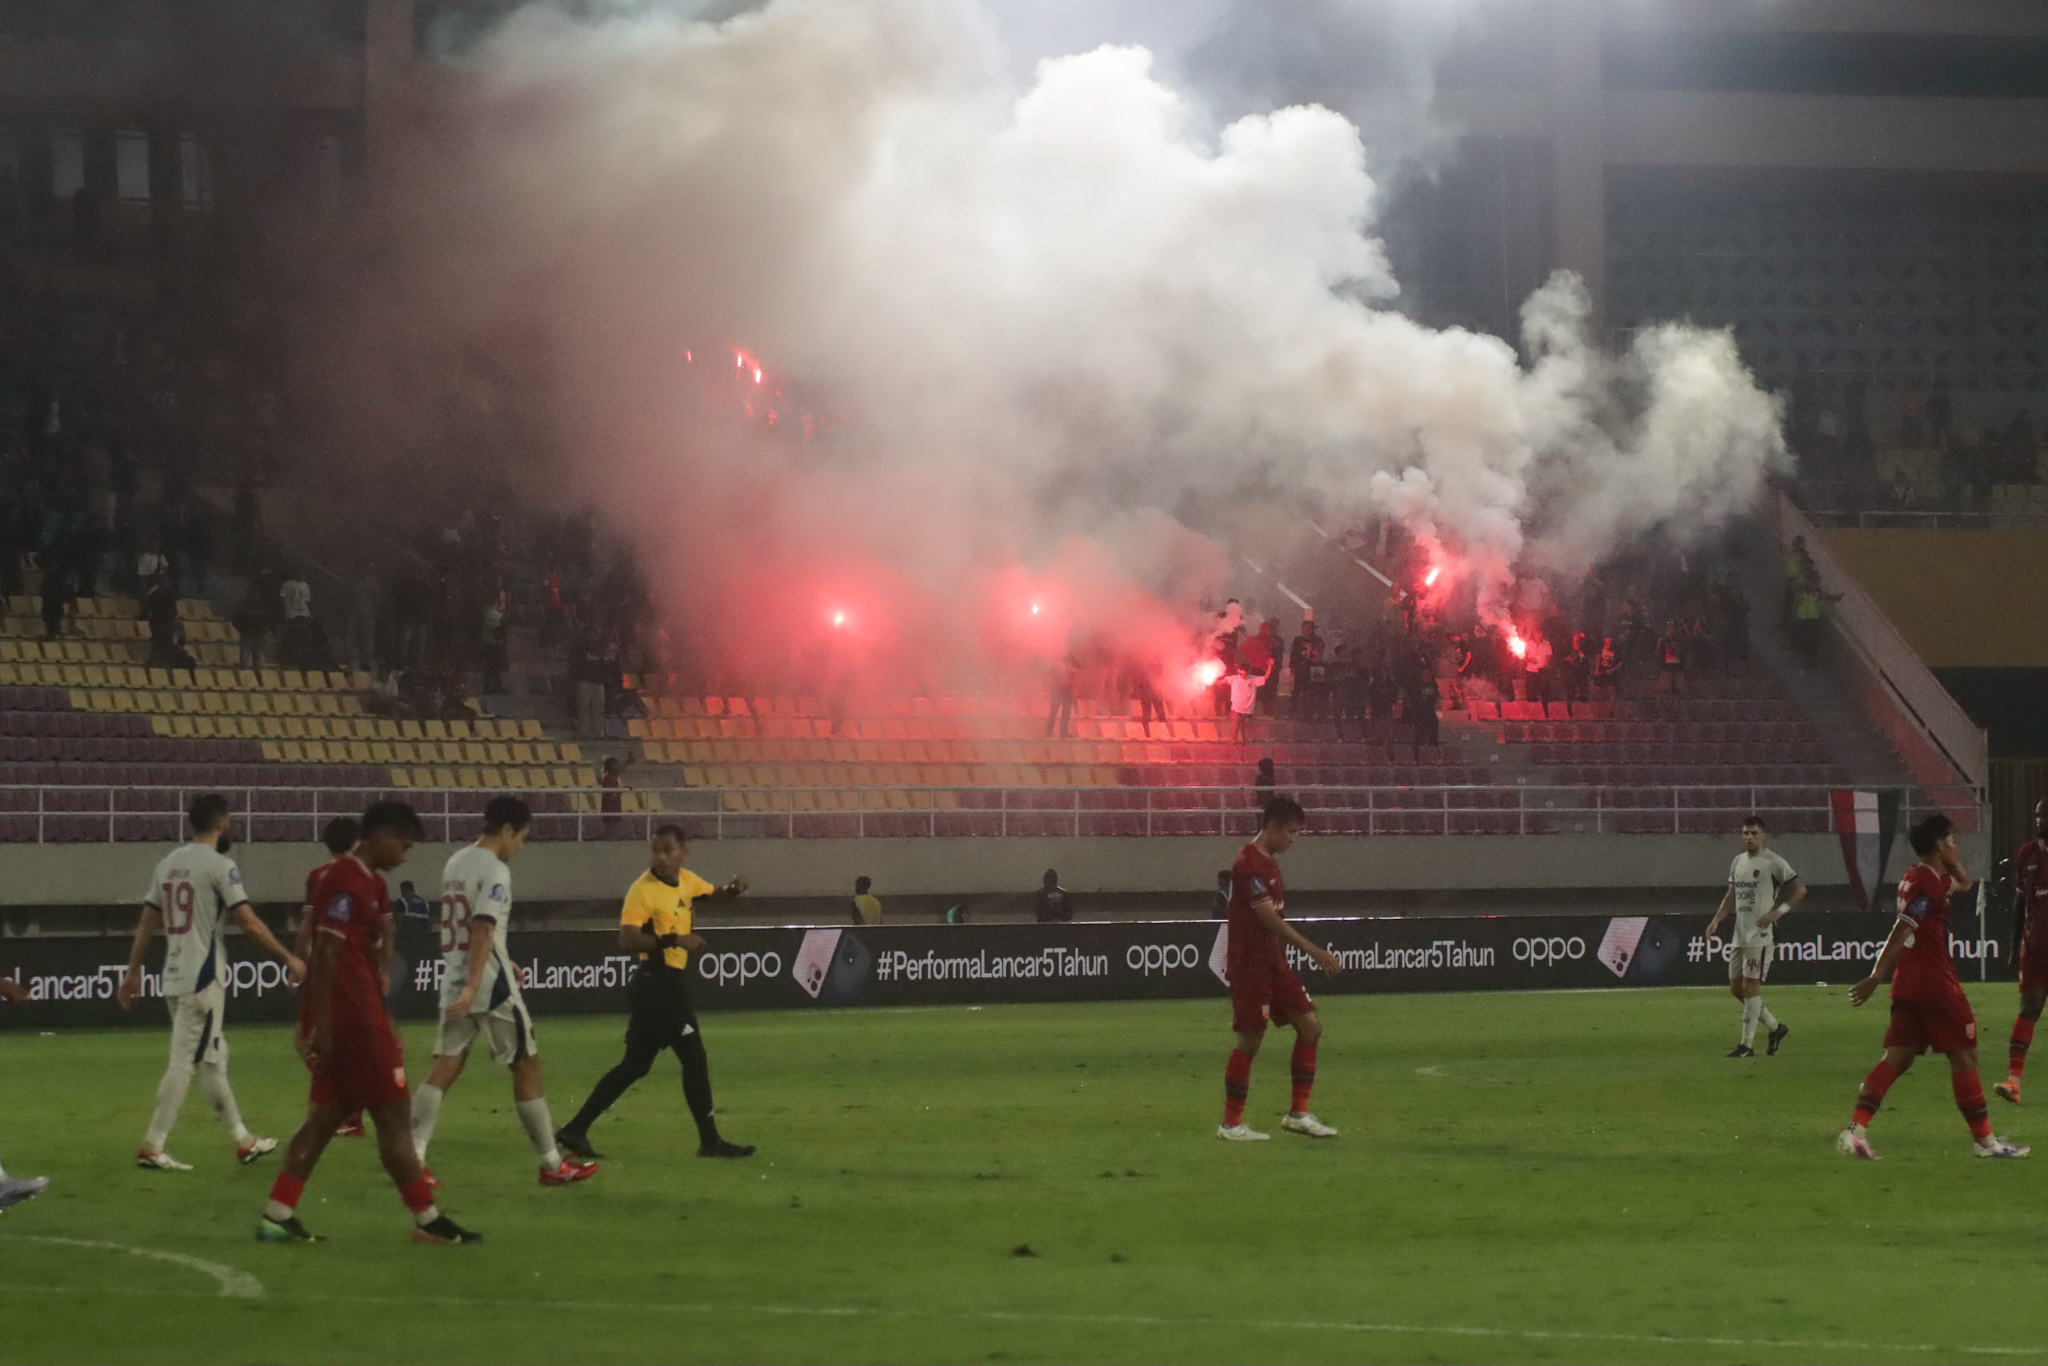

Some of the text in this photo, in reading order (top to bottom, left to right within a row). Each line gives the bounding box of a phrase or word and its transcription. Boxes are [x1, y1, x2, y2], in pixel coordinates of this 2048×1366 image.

[162, 881, 195, 934] 19
[699, 951, 781, 985] oppo
[877, 944, 1199, 981] #PerformaLancar5Tahun oppo
[1285, 937, 1586, 972] #PeformaLancar5Tahun oppo
[1747, 958, 1761, 972] 44
